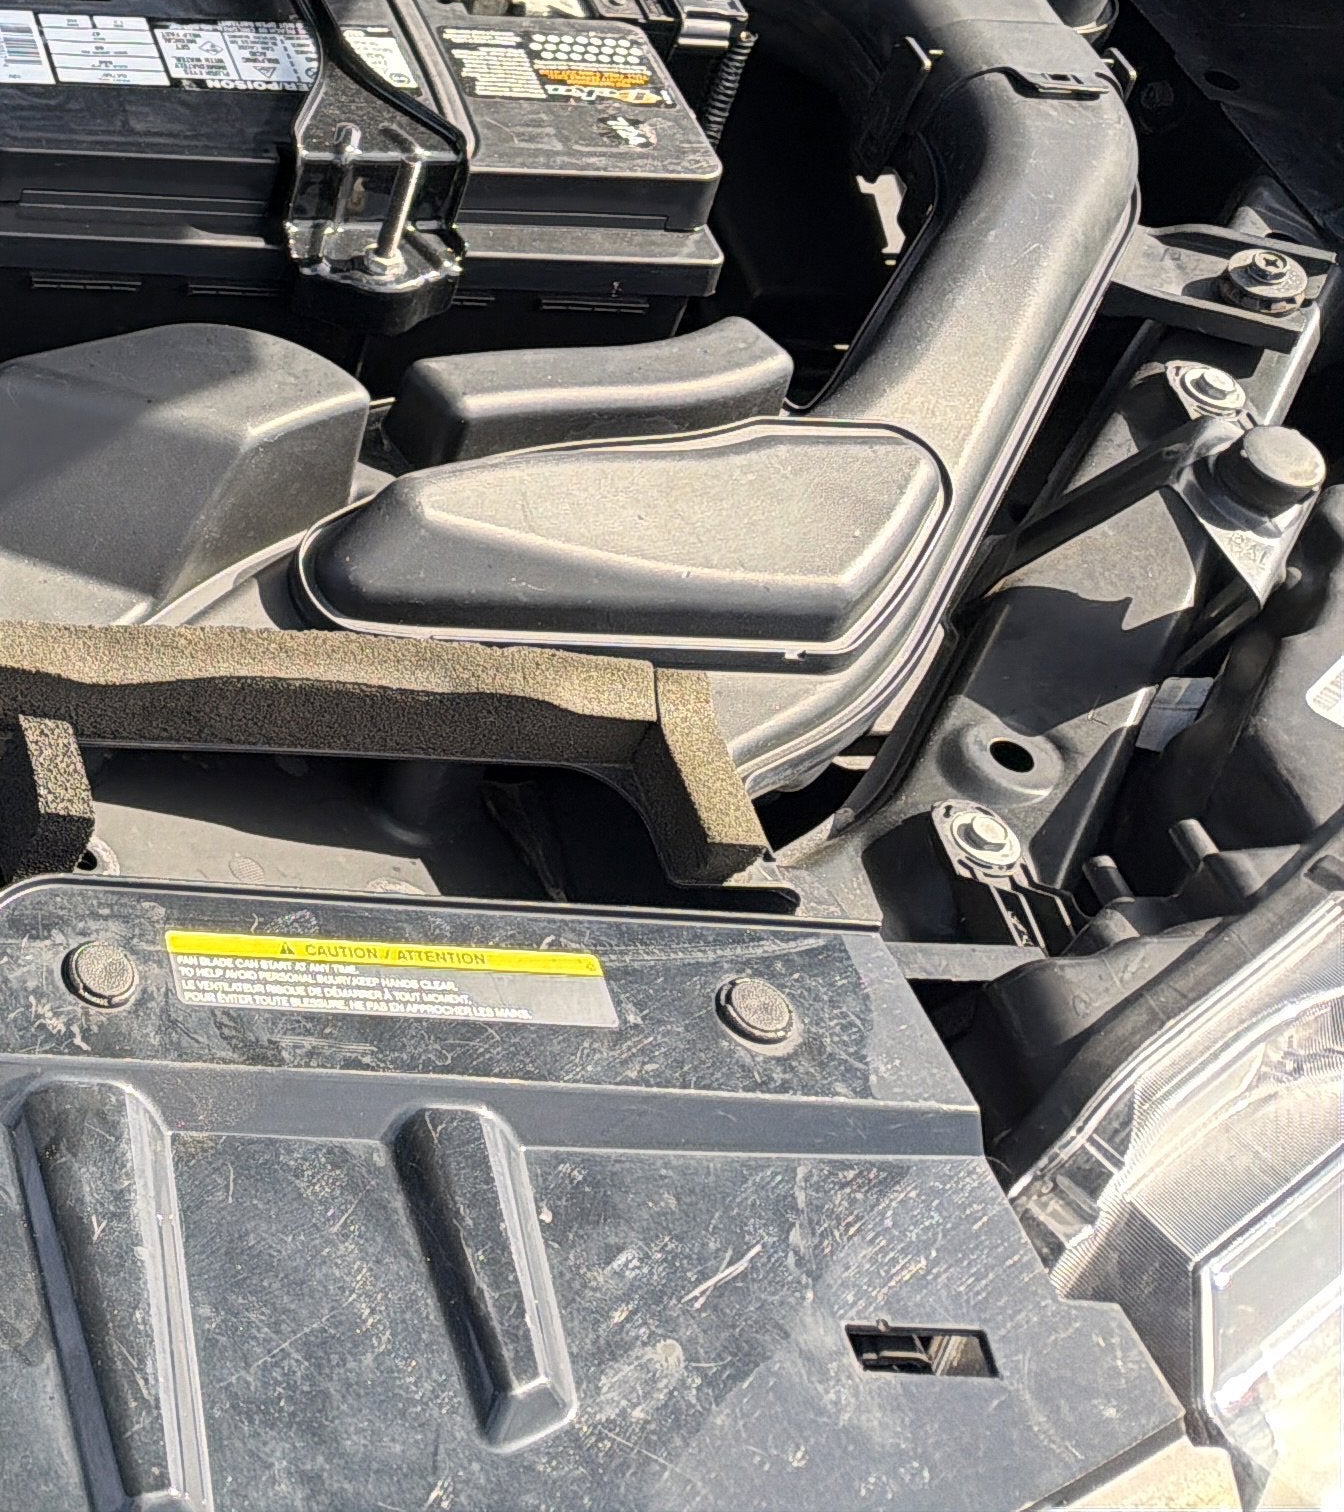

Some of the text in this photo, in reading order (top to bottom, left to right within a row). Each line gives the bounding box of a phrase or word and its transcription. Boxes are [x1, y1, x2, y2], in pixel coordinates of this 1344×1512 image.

[235, 958, 258, 969] CAN
[304, 944, 378, 959] CAUTION
[397, 951, 486, 965] ATTENTION
[178, 967, 195, 978] TO
[196, 968, 223, 979] HELP
[225, 969, 258, 981] AVOID
[259, 971, 315, 984] PERSONAL
[381, 978, 419, 989] HANDS
[185, 991, 216, 1002] POUR
[254, 995, 290, 1006] TOUTE
[366, 1001, 388, 1012] PAS
[405, 1003, 473, 1017] APPROCHER
[393, 991, 420, 1002] TOUT
